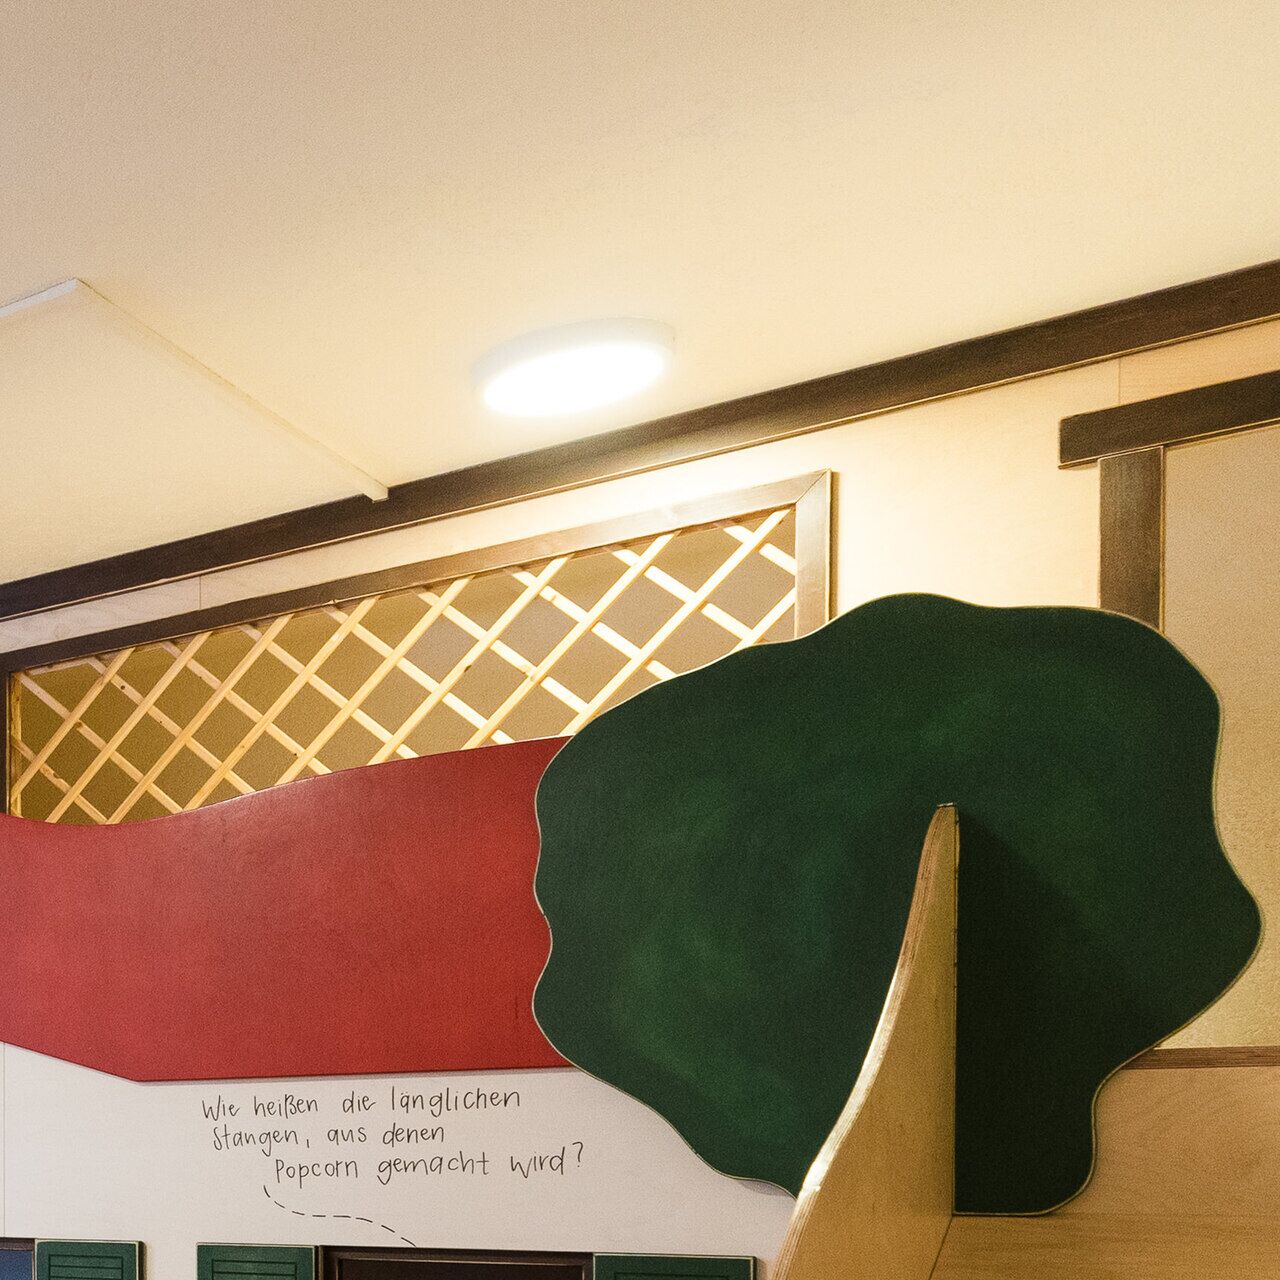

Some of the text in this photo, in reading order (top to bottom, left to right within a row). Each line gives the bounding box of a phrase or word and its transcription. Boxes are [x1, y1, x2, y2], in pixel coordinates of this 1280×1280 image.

[202, 1085, 521, 1122] Wie heißen die länglichen
[213, 1122, 445, 1157] Stangen, aus denen
[275, 1141, 584, 1190] Popcorn gemacht wird?
